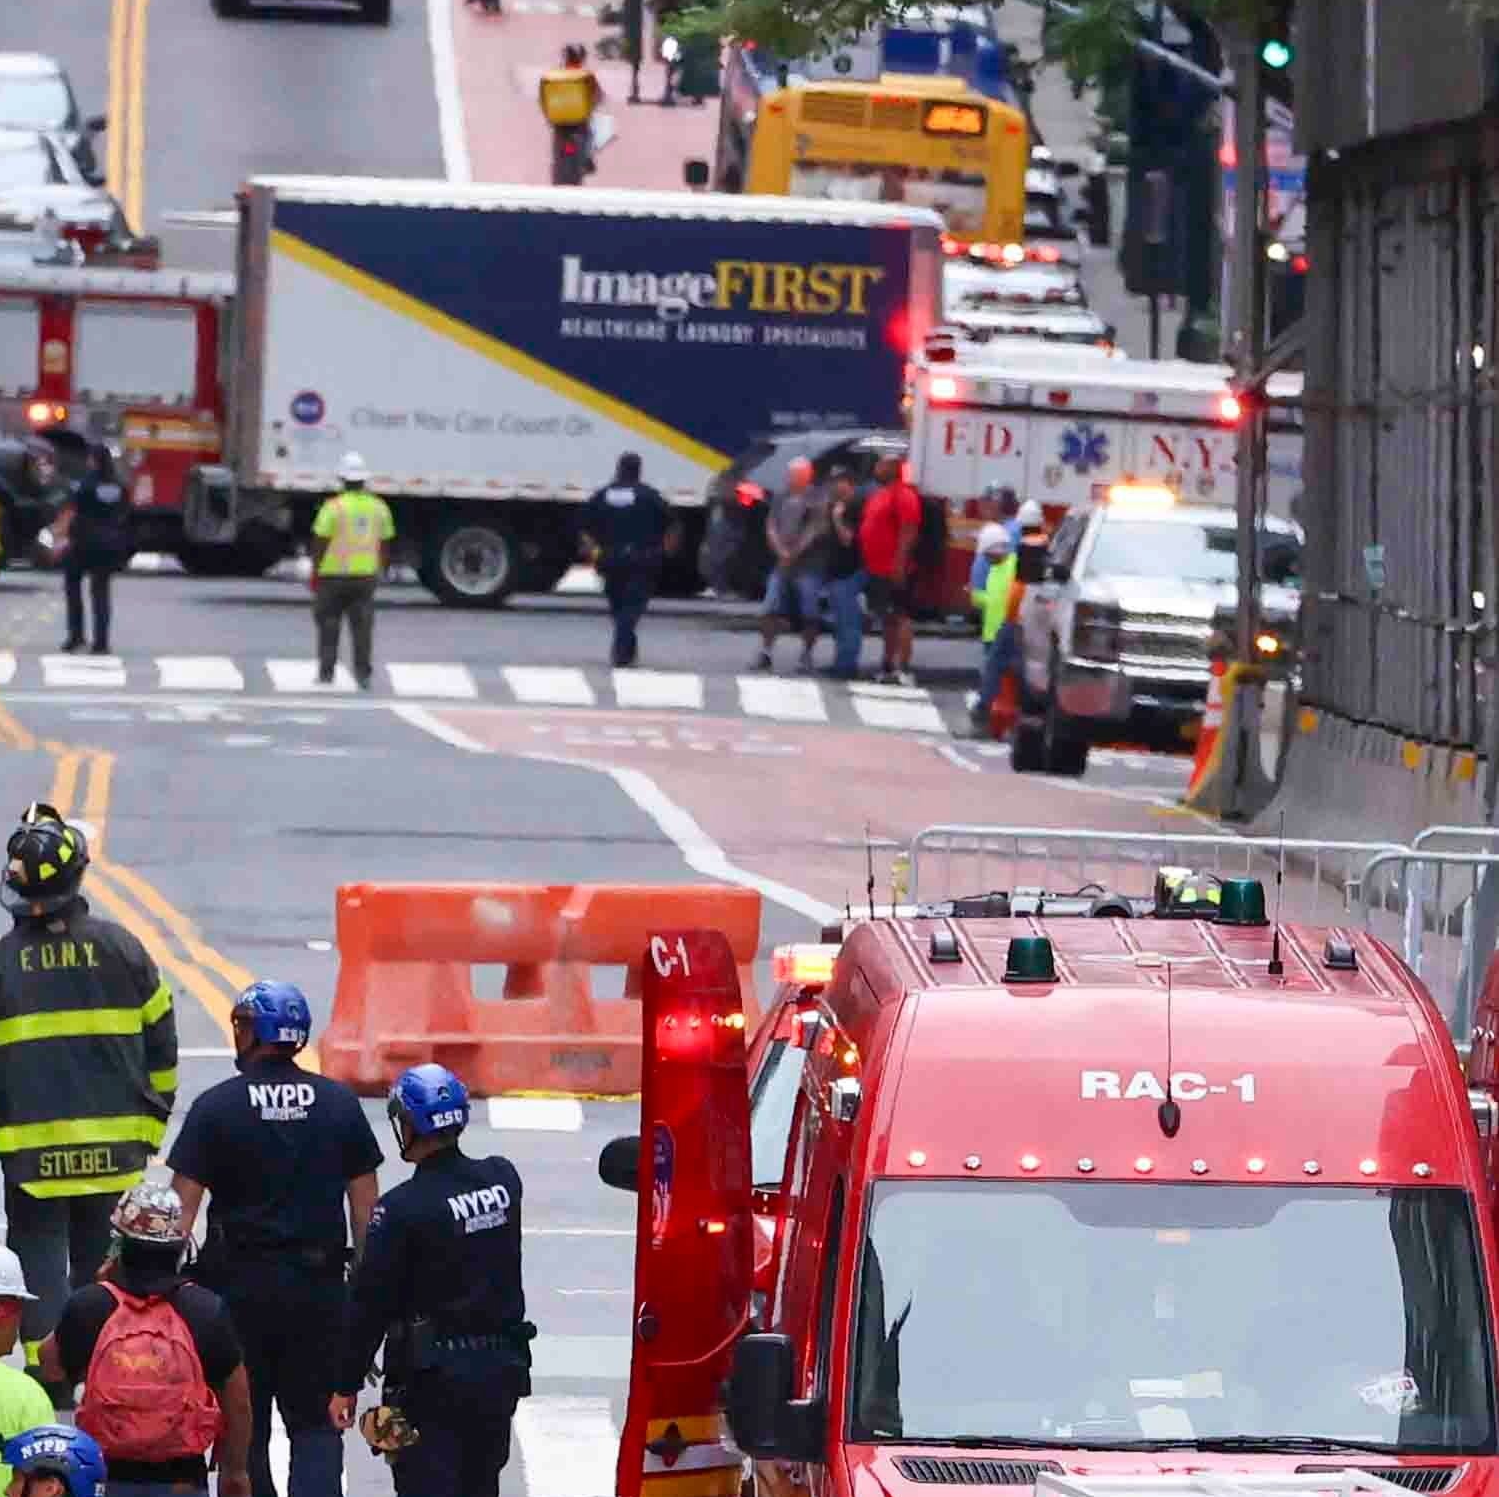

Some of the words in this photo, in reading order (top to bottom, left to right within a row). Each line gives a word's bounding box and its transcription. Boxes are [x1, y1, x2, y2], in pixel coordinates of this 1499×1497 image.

[561, 254, 876, 321] ImageFIRST
[651, 934, 690, 977] C-1
[248, 1083, 316, 1108] NYPD
[1081, 1070, 1256, 1102] RAC-1
[432, 1109, 463, 1128] ESU
[39, 1149, 119, 1177] STIEBEL
[447, 1184, 511, 1221] NYPD
[20, 1438, 68, 1460] NYPD
